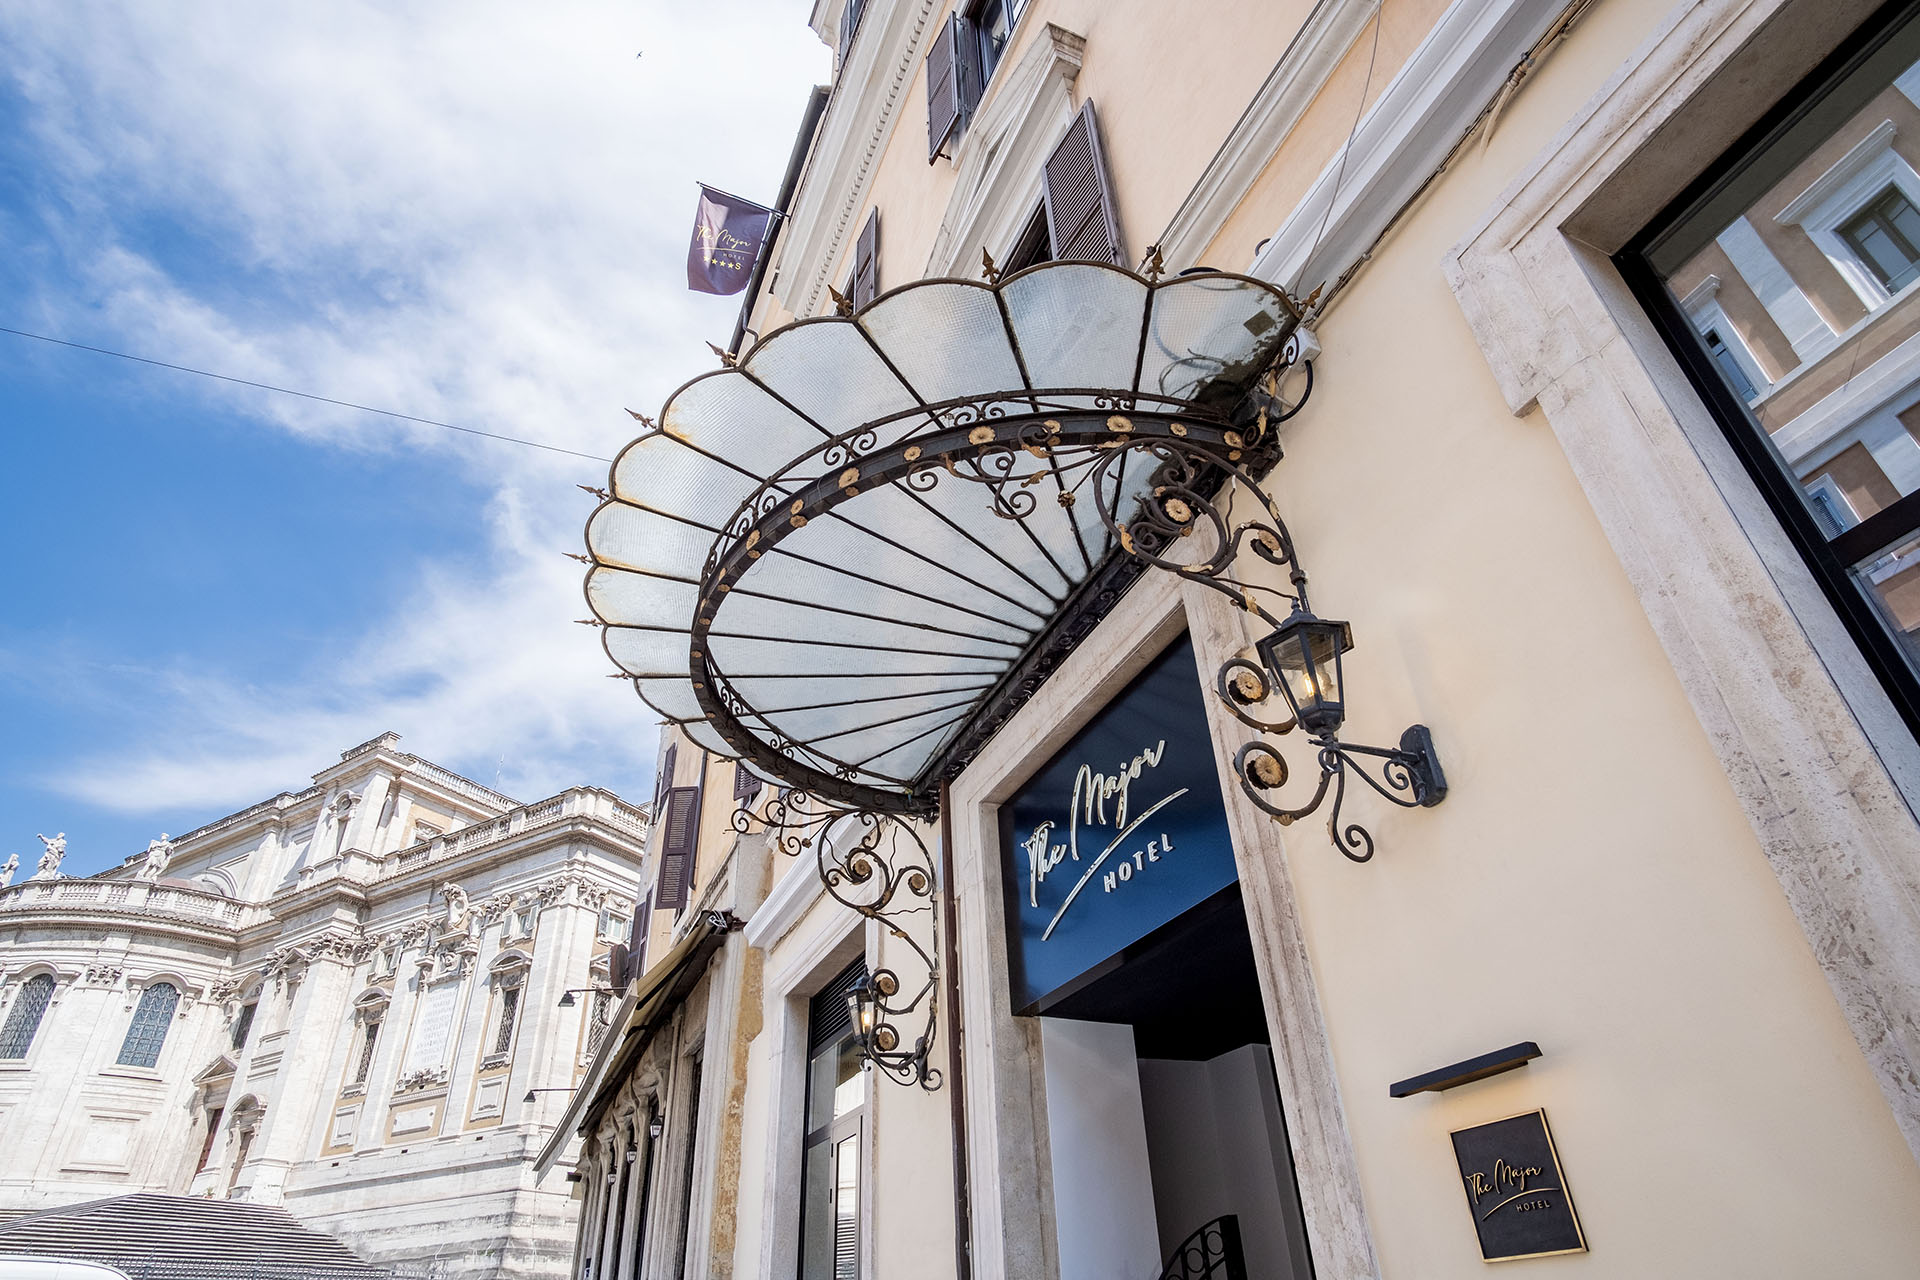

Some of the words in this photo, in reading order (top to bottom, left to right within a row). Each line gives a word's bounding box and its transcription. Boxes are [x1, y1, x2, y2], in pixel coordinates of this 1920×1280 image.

[715, 229, 751, 249] Major
[1020, 820, 1067, 908] The
[1069, 739, 1166, 861] Major
[1103, 833, 1174, 893] HOTEL
[1465, 1171, 1493, 1205] The
[1494, 1158, 1543, 1194] Major
[1515, 1200, 1551, 1212] HOTEL
